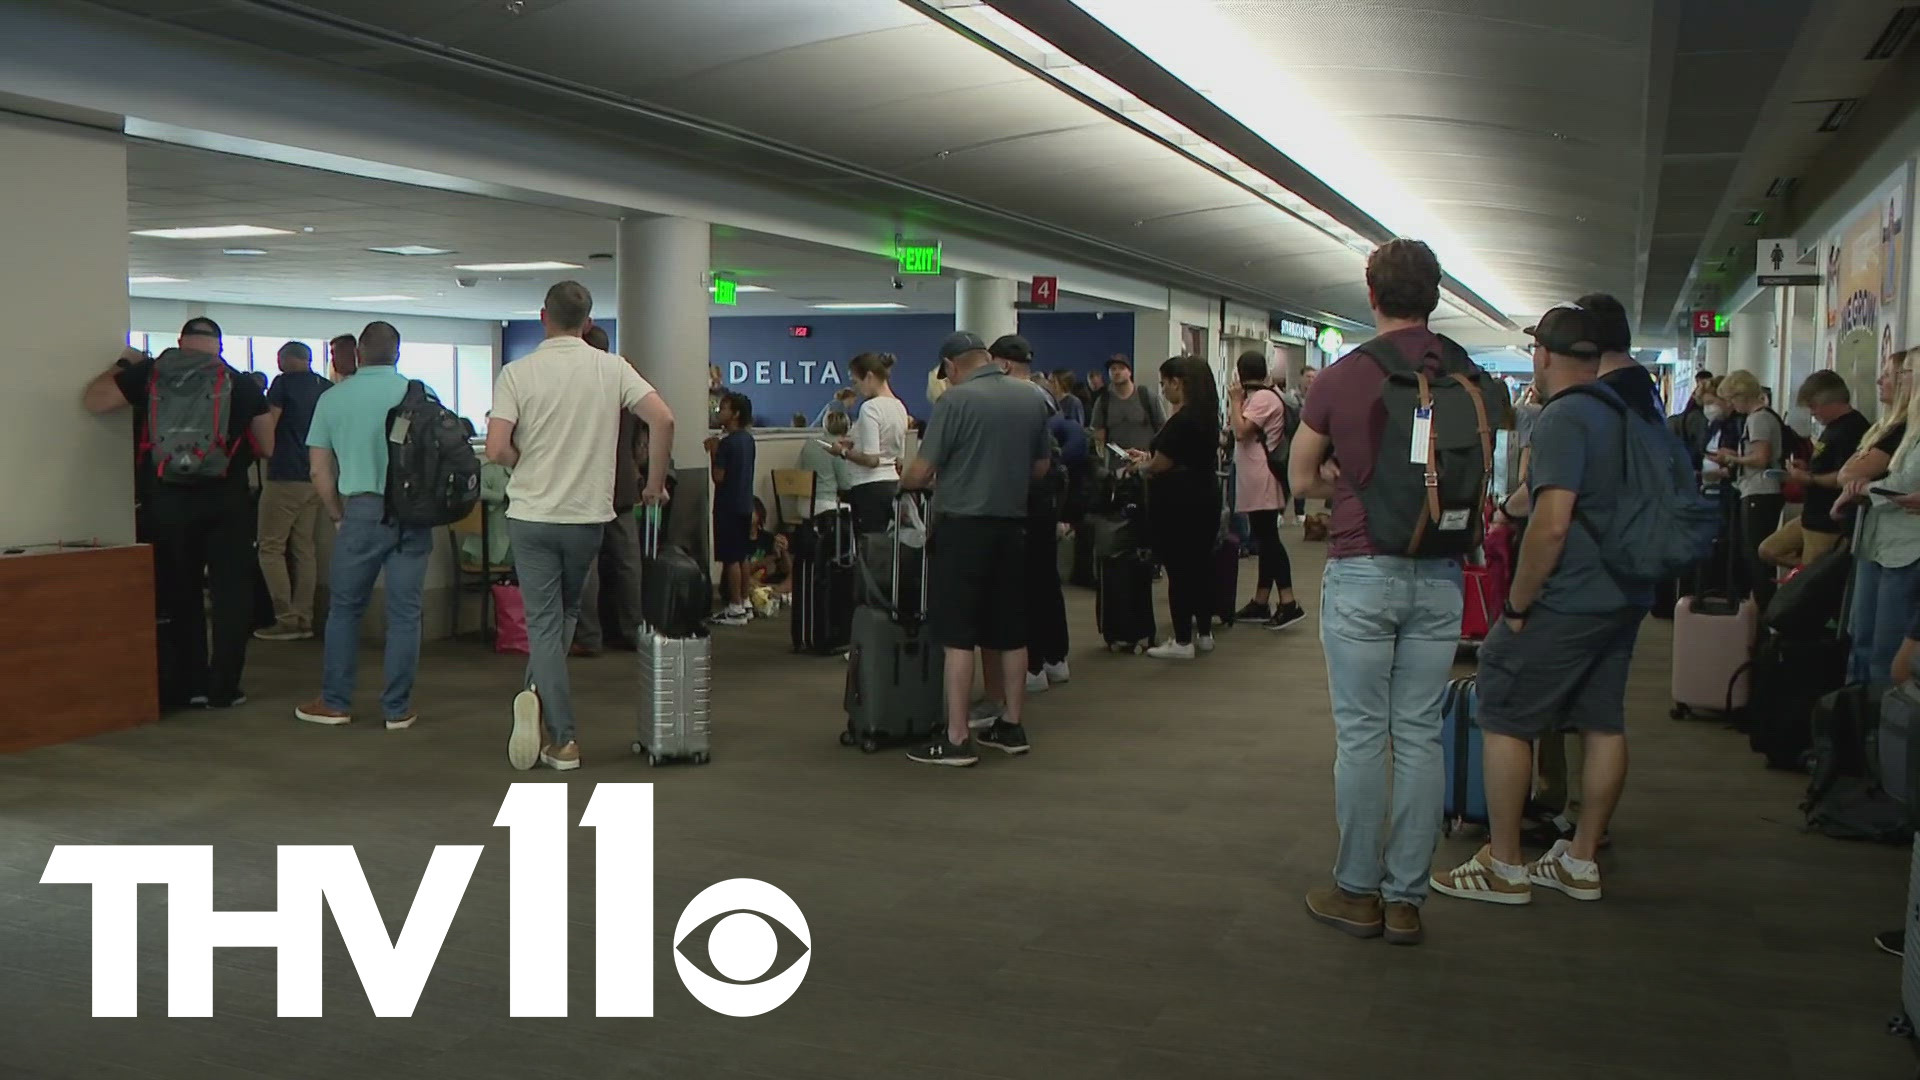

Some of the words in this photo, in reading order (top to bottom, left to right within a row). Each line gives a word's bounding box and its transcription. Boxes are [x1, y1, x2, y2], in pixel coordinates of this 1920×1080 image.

[906, 247, 934, 271] EXIT
[719, 280, 734, 303] EXIT
[1037, 280, 1050, 299] 4
[1700, 314, 1710, 329] 5
[729, 360, 841, 385] DELTA
